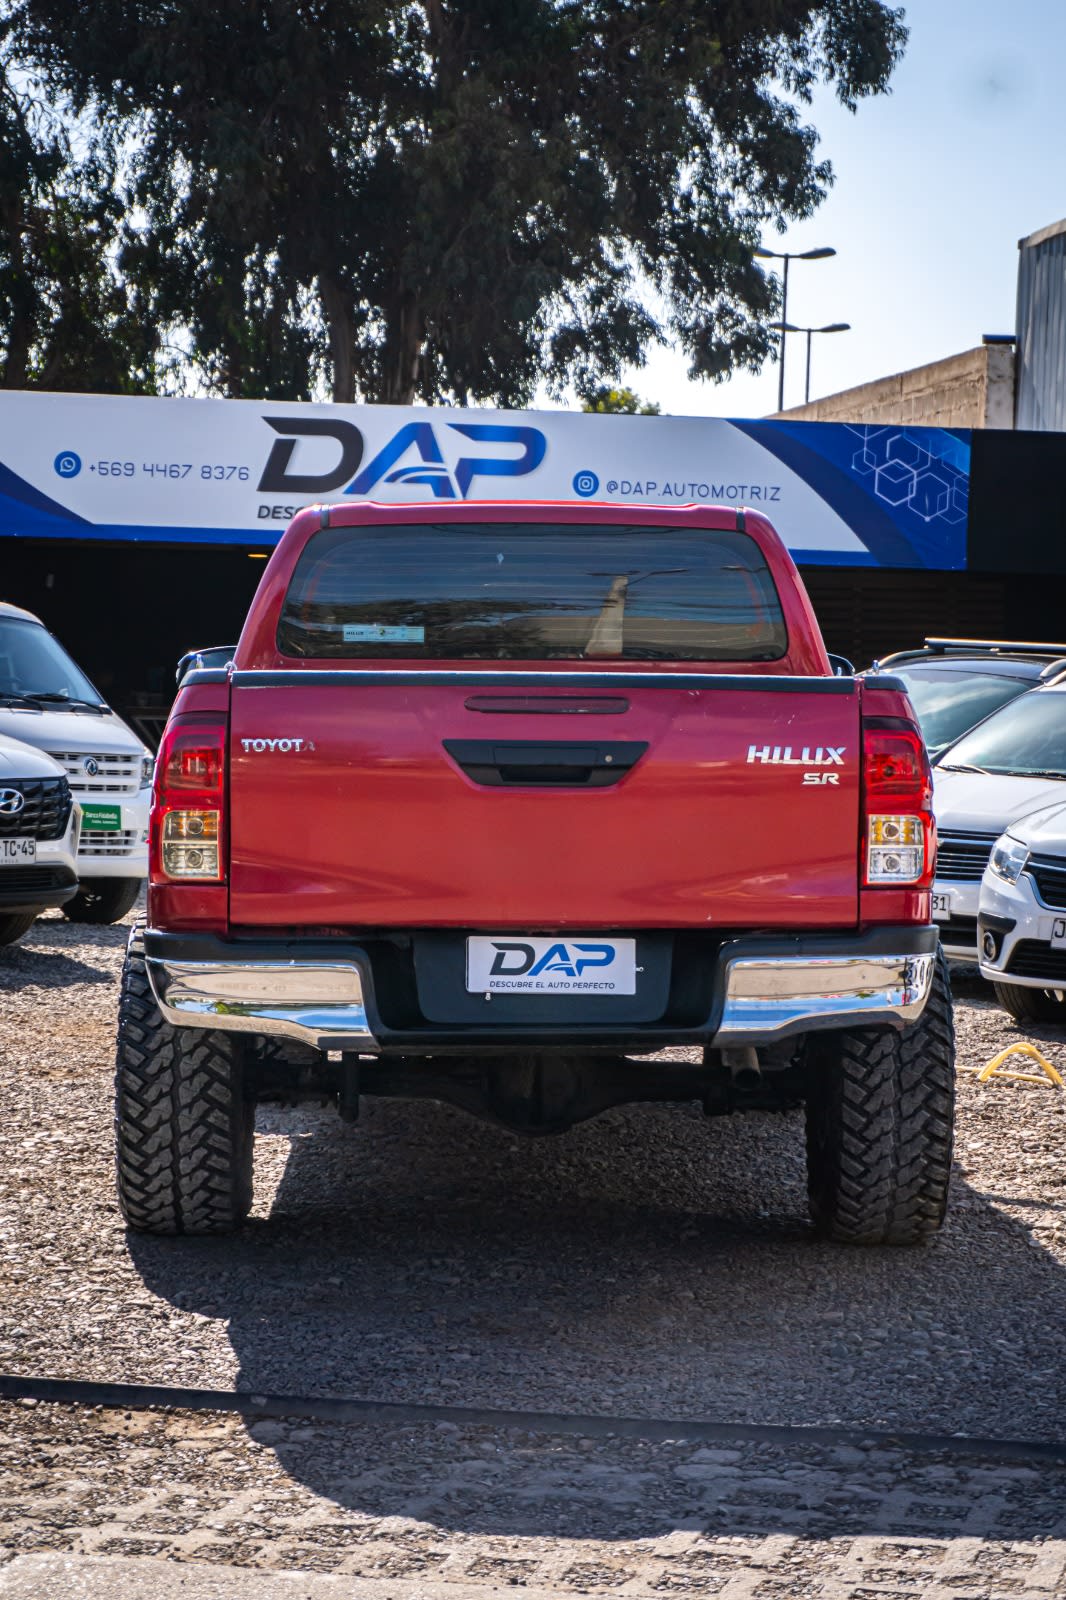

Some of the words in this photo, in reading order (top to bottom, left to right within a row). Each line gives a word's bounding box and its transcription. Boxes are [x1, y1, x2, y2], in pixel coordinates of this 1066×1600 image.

[256, 416, 546, 500] DAP
[89, 461, 135, 477] +569
[142, 463, 193, 479] 4467
[200, 465, 250, 481] 8376
[606, 480, 782, 501] @DAP.AUTOMOTRIZ
[746, 745, 847, 765] HILUX
[802, 772, 840, 785] SR
[489, 942, 616, 977] DAP
[489, 980, 533, 989] DESCUBRE
[535, 981, 545, 989] EL
[547, 981, 571, 990] AUTO
[572, 982, 616, 991] PERFECTO
